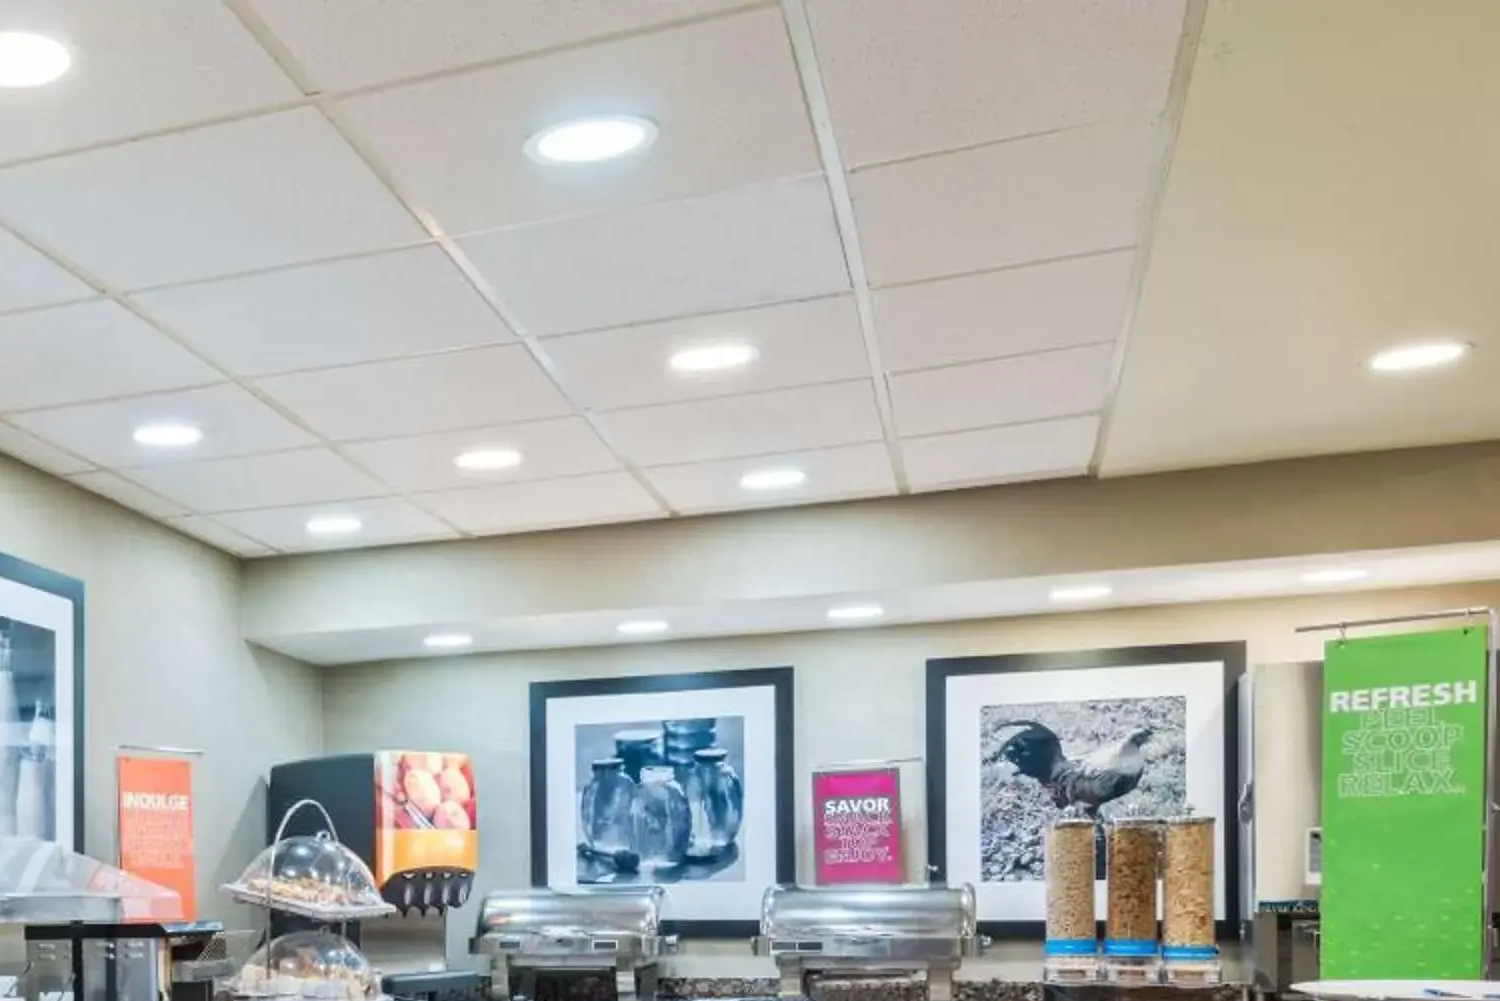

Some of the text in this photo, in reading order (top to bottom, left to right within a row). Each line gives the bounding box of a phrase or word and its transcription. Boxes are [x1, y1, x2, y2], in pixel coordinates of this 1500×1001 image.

[1329, 680, 1477, 712] REFRESH
[1342, 721, 1465, 755] SCOOP
[1350, 746, 1452, 773] SLICE
[123, 791, 189, 811] INDULGE
[824, 797, 889, 814] SAVOR
